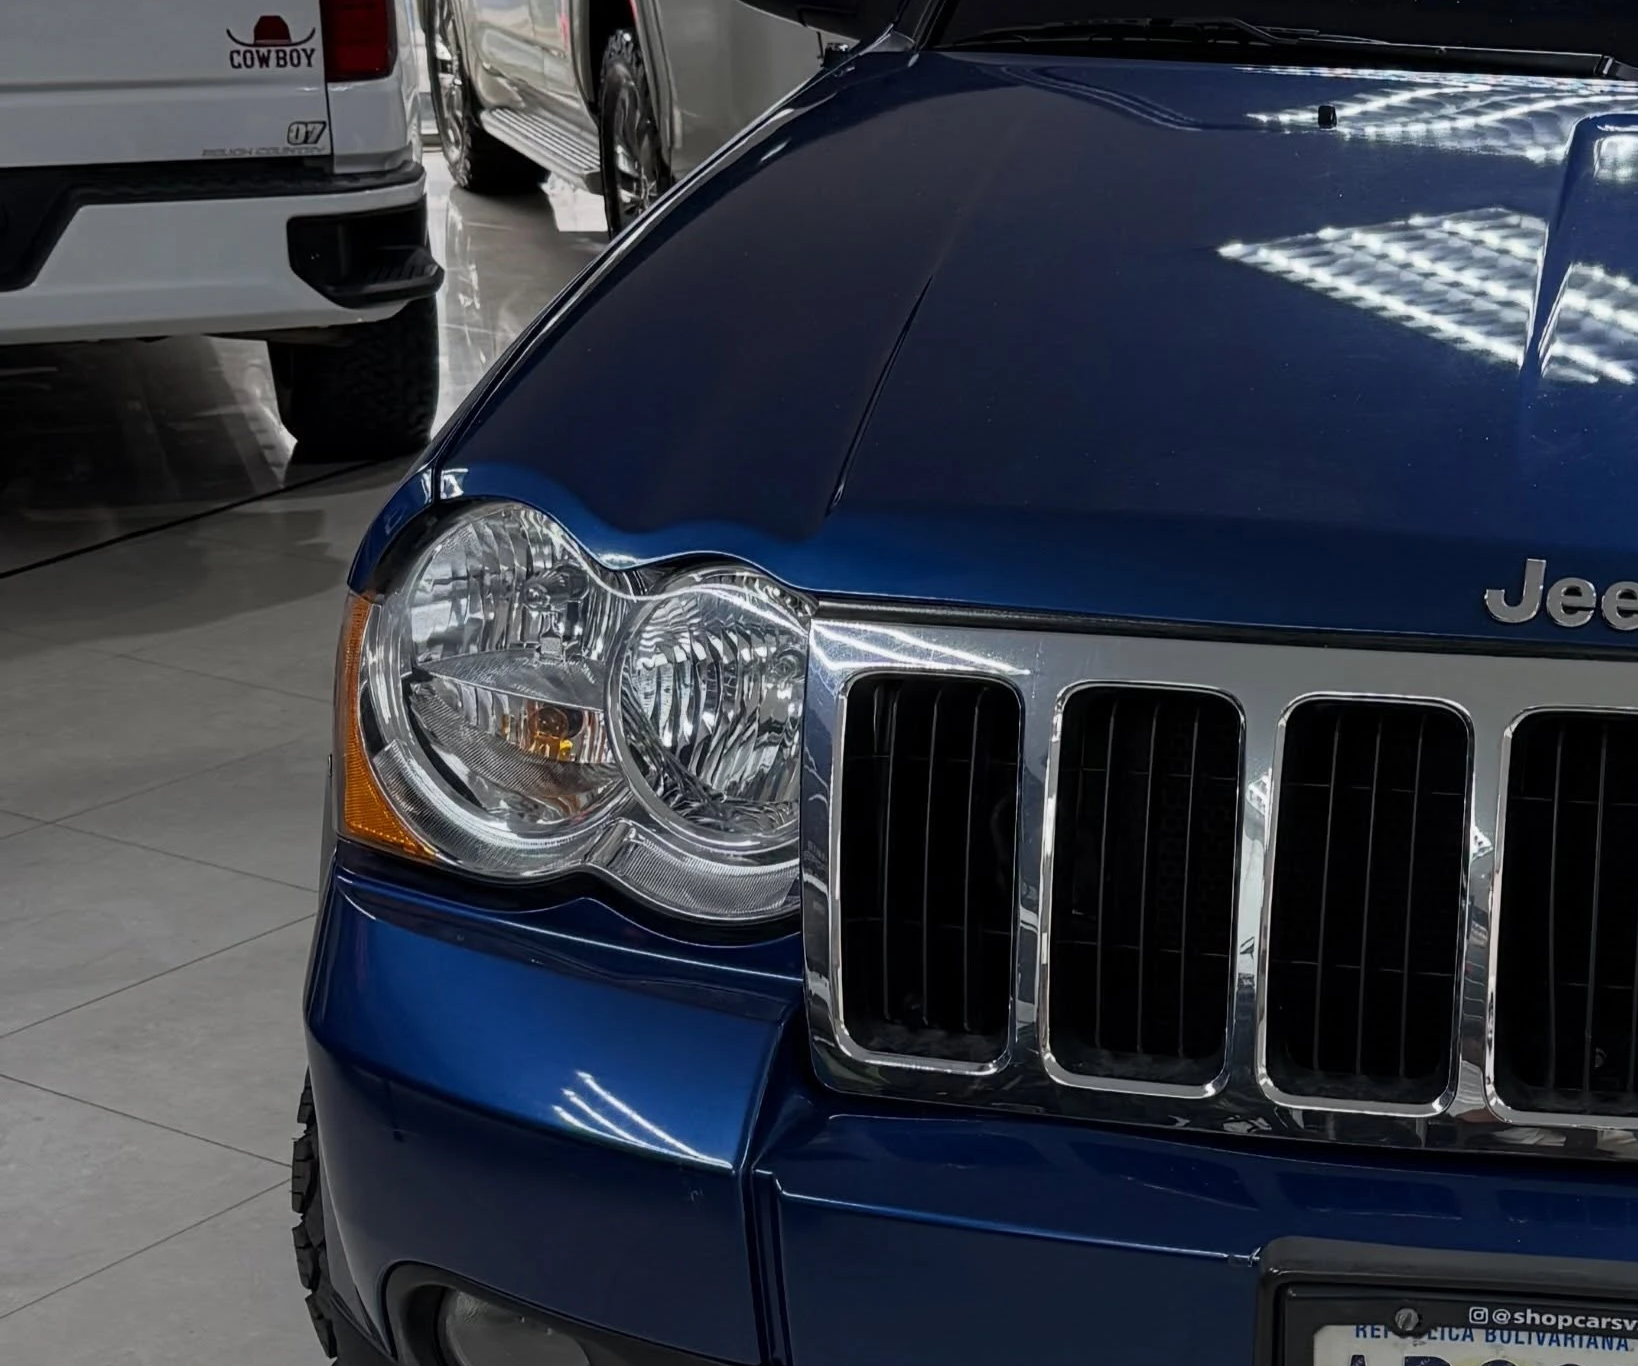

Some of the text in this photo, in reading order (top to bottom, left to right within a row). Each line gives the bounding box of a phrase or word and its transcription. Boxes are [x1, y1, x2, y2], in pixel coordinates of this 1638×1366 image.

[229, 47, 316, 70] COWBOY
[286, 120, 327, 146] 07
[1485, 1328, 1629, 1352] BOLIVARIANA
